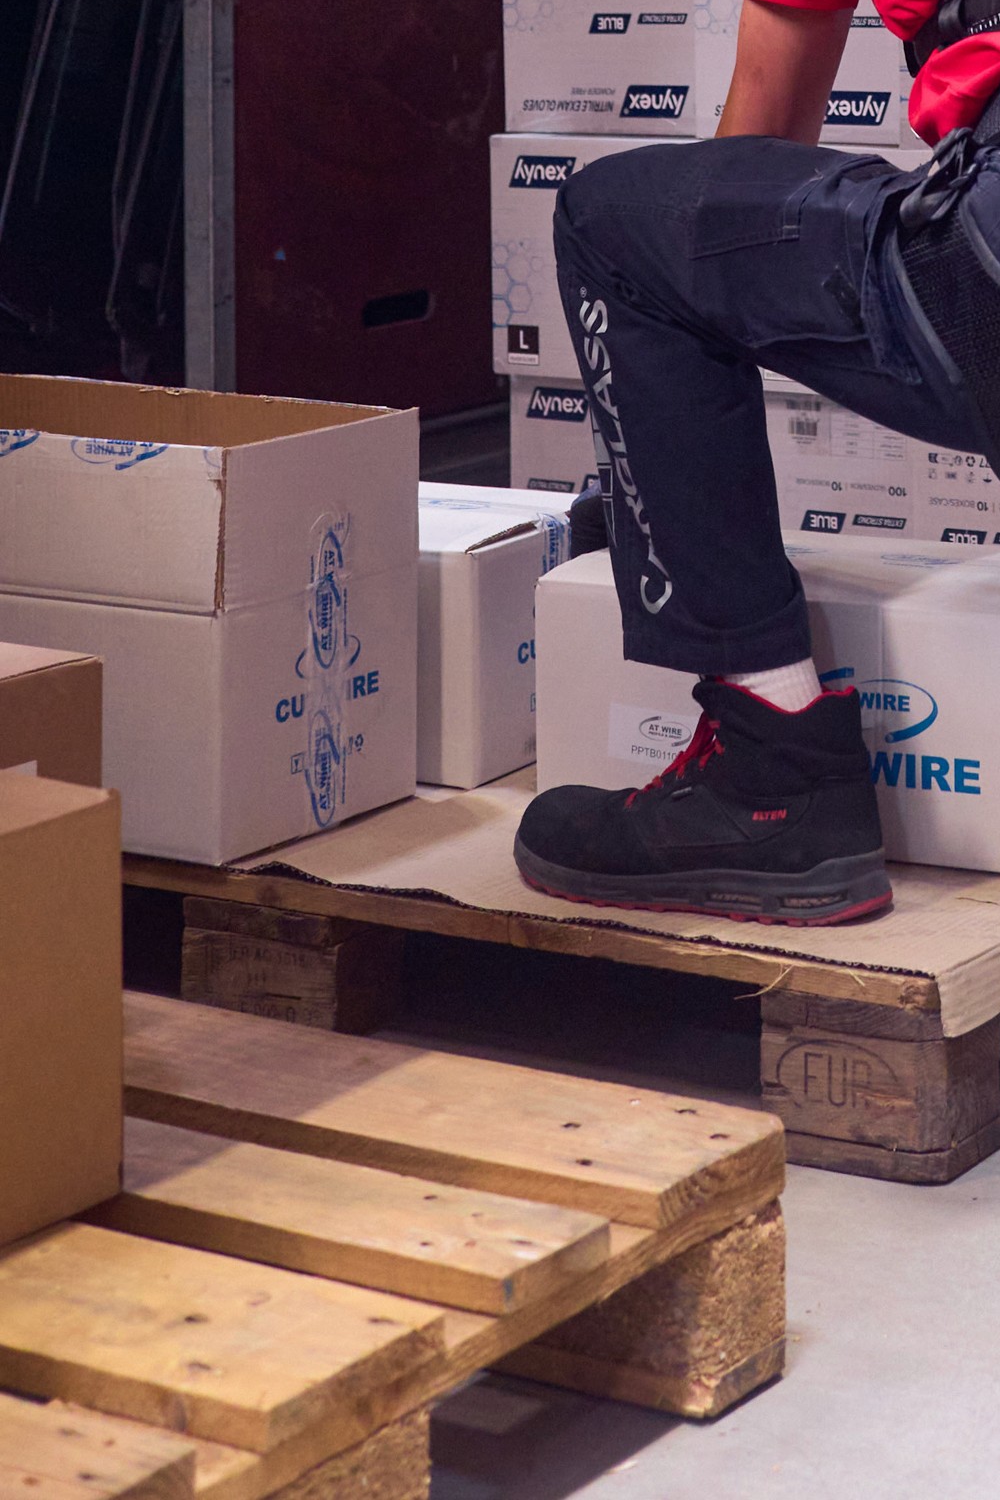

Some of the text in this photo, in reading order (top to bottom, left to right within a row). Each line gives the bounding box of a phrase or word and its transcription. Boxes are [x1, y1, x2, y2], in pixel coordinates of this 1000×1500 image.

[598, 17, 624, 30] BLUE
[519, 330, 529, 349] L
[832, 482, 907, 497] 100 10
[977, 501, 988, 512] 10
[810, 514, 838, 528] BLUE
[649, 724, 683, 736] AT WIRE
[868, 750, 981, 795] WIRE
